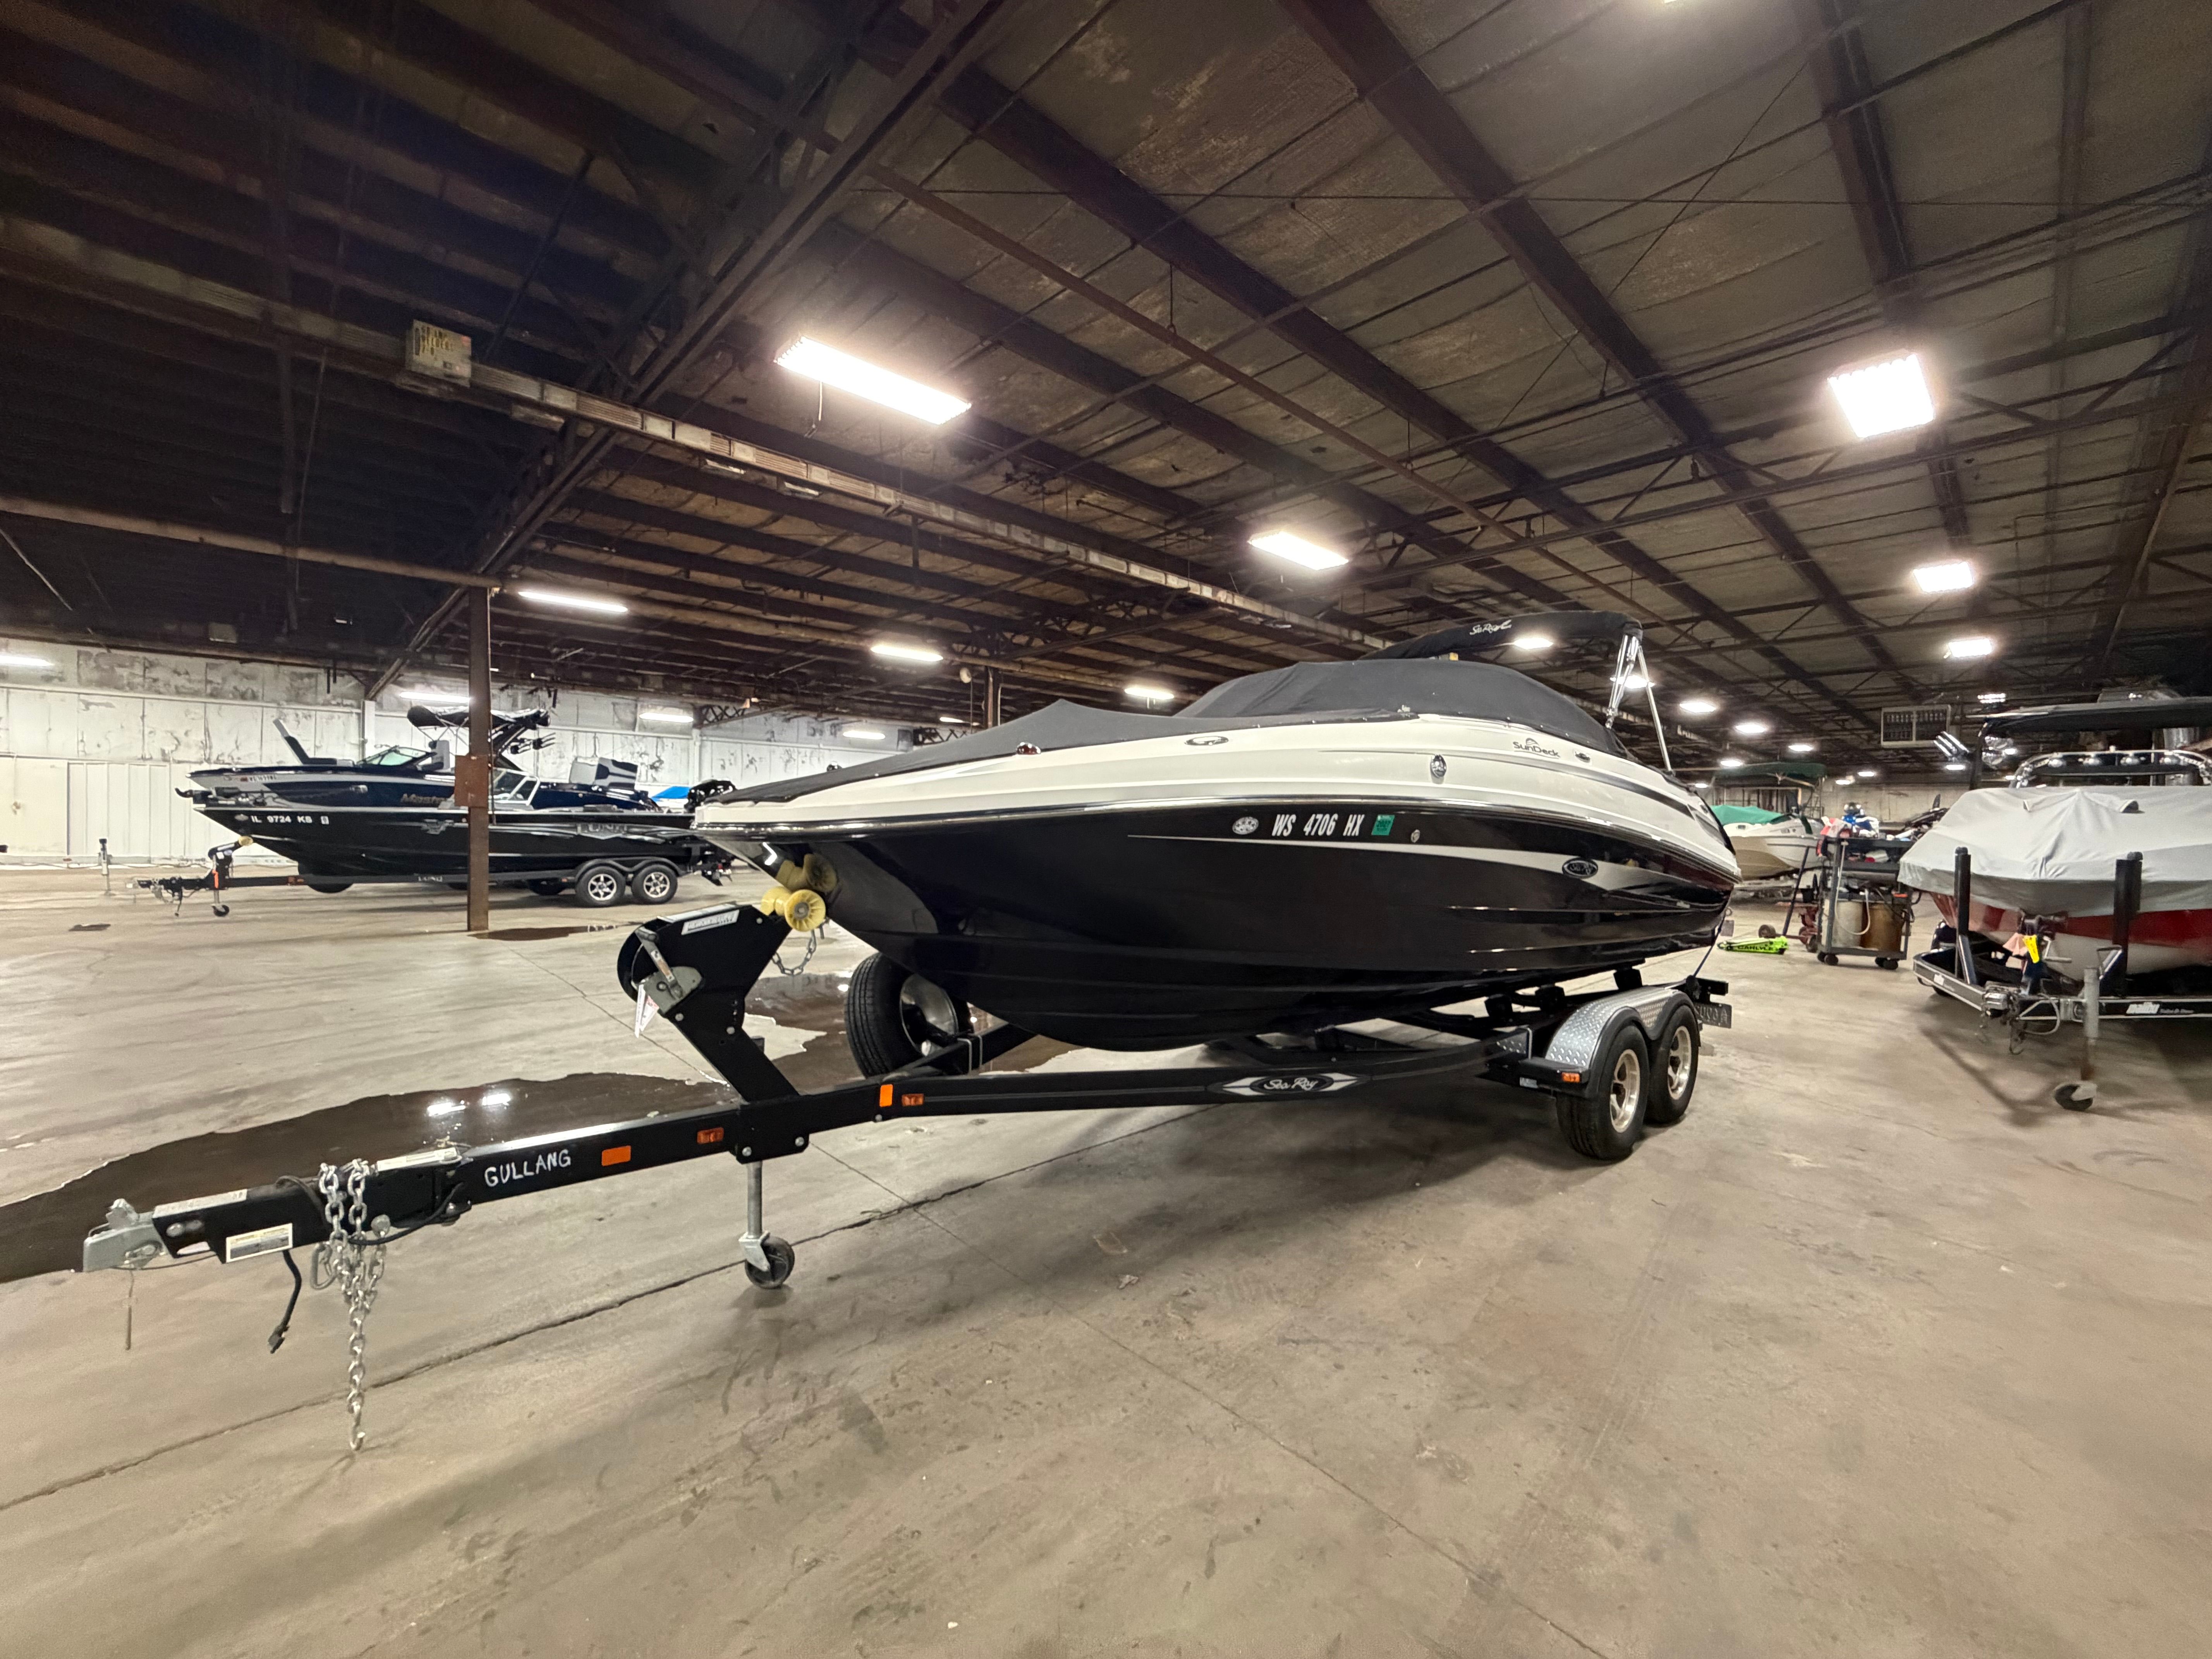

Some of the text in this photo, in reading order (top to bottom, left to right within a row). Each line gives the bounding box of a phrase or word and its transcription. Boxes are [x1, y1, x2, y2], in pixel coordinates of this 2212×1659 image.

[1513, 742, 1561, 757] SunDeck
[266, 815, 292, 823] 9724
[1272, 813, 1365, 836] WS 4706 HX
[1264, 1077, 1318, 1091] Sea Ray
[484, 1149, 571, 1187] GULLANG
